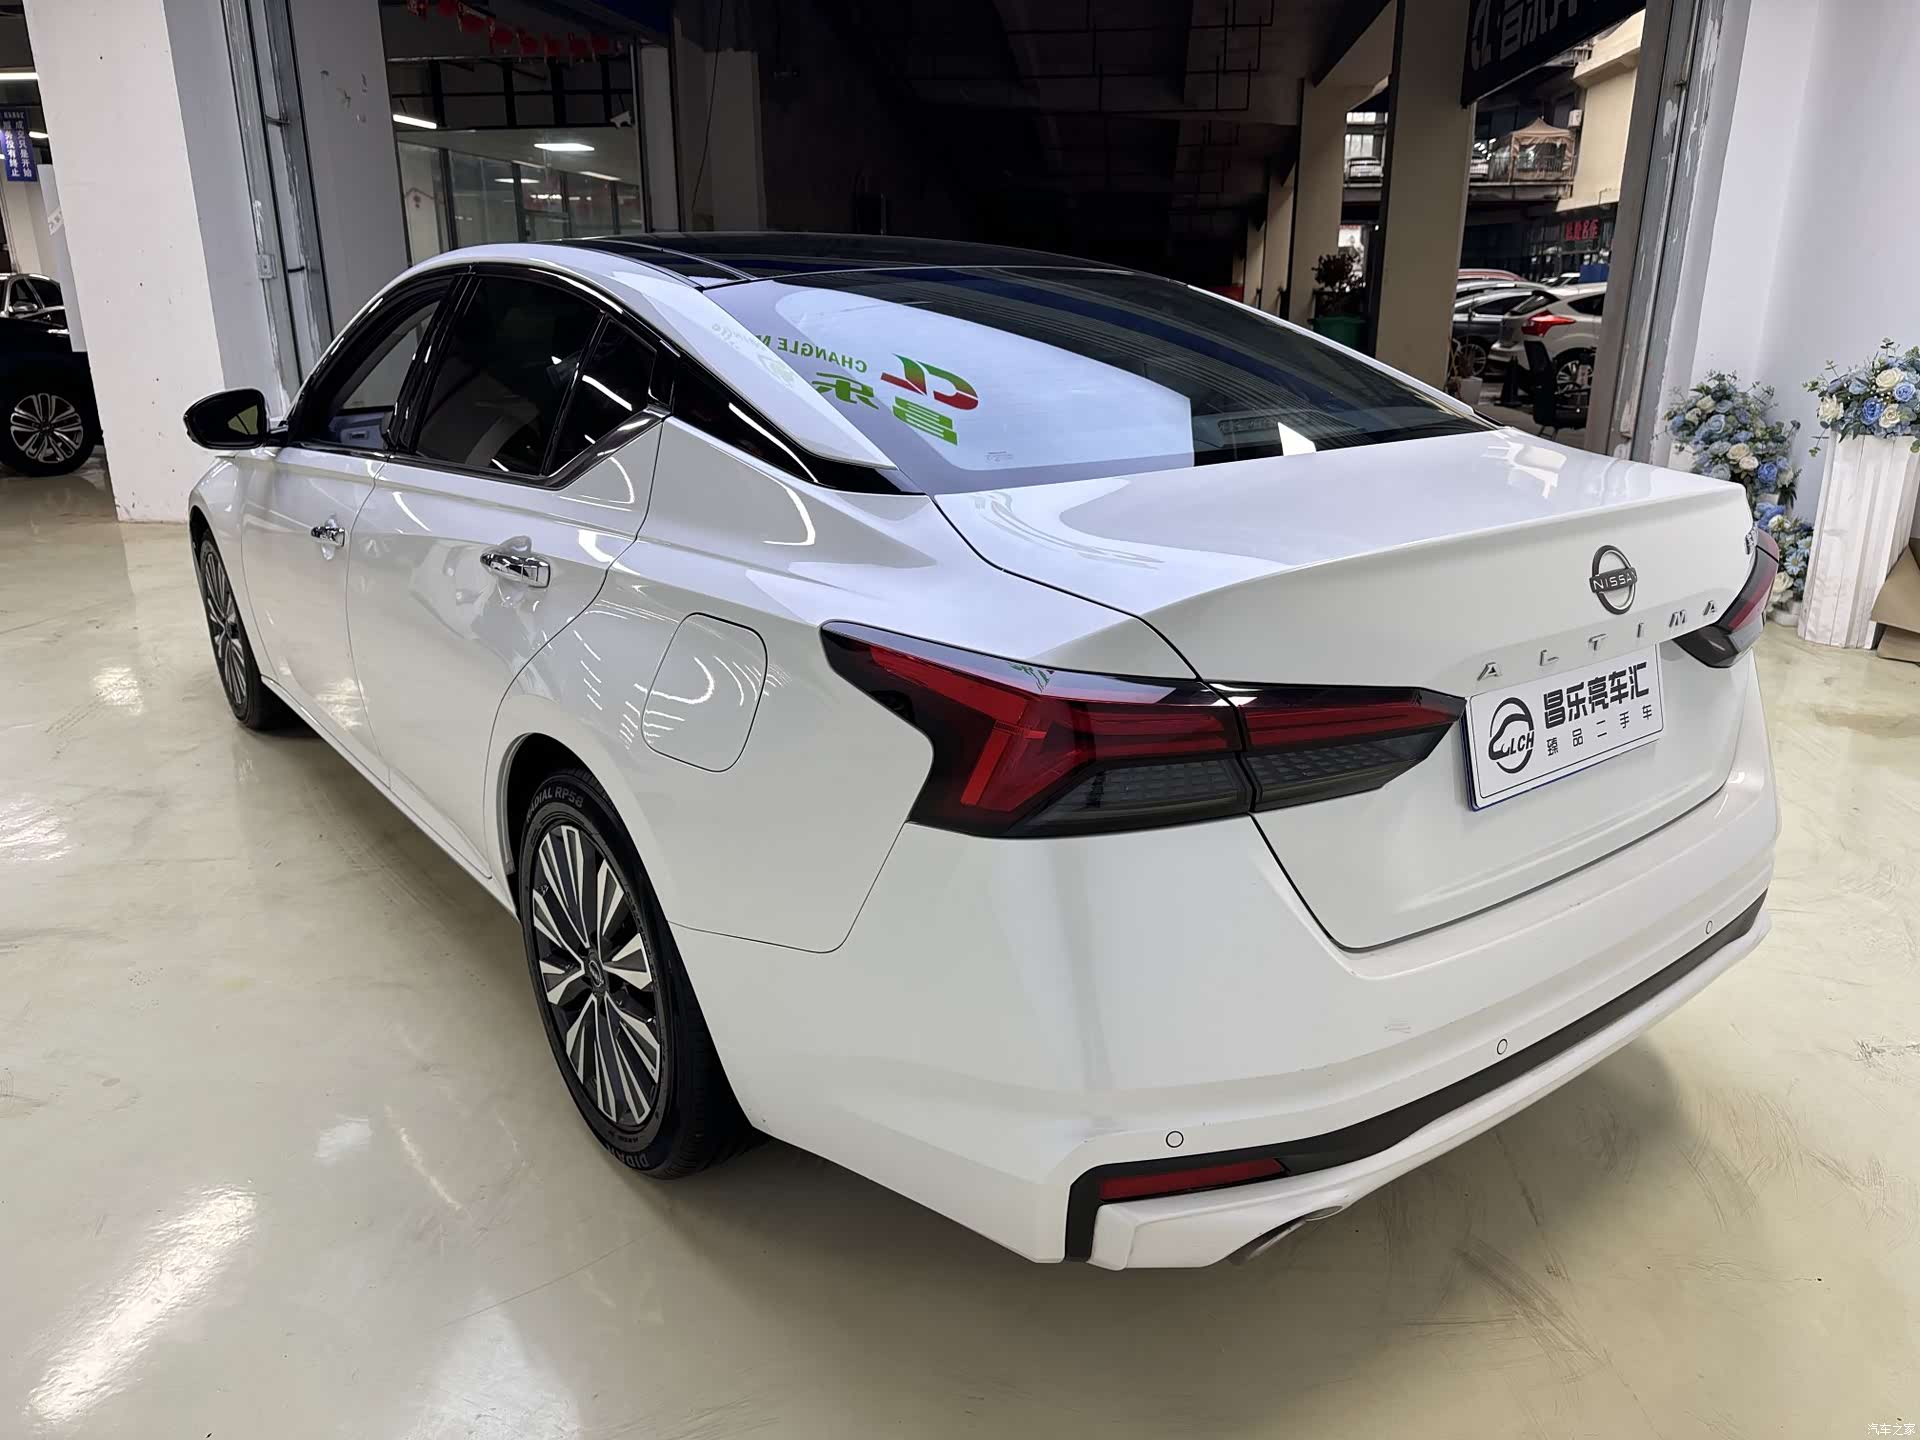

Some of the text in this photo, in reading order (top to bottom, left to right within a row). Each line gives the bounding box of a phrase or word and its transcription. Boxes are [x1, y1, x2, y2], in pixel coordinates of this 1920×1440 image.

[1592, 571, 1637, 591] NISSAN
[1477, 600, 1717, 681] ALTIMA
[1543, 661, 1649, 729] 昌乐亮车汇
[1546, 704, 1653, 757] 臻品二手车
[554, 786, 584, 808] RP58
